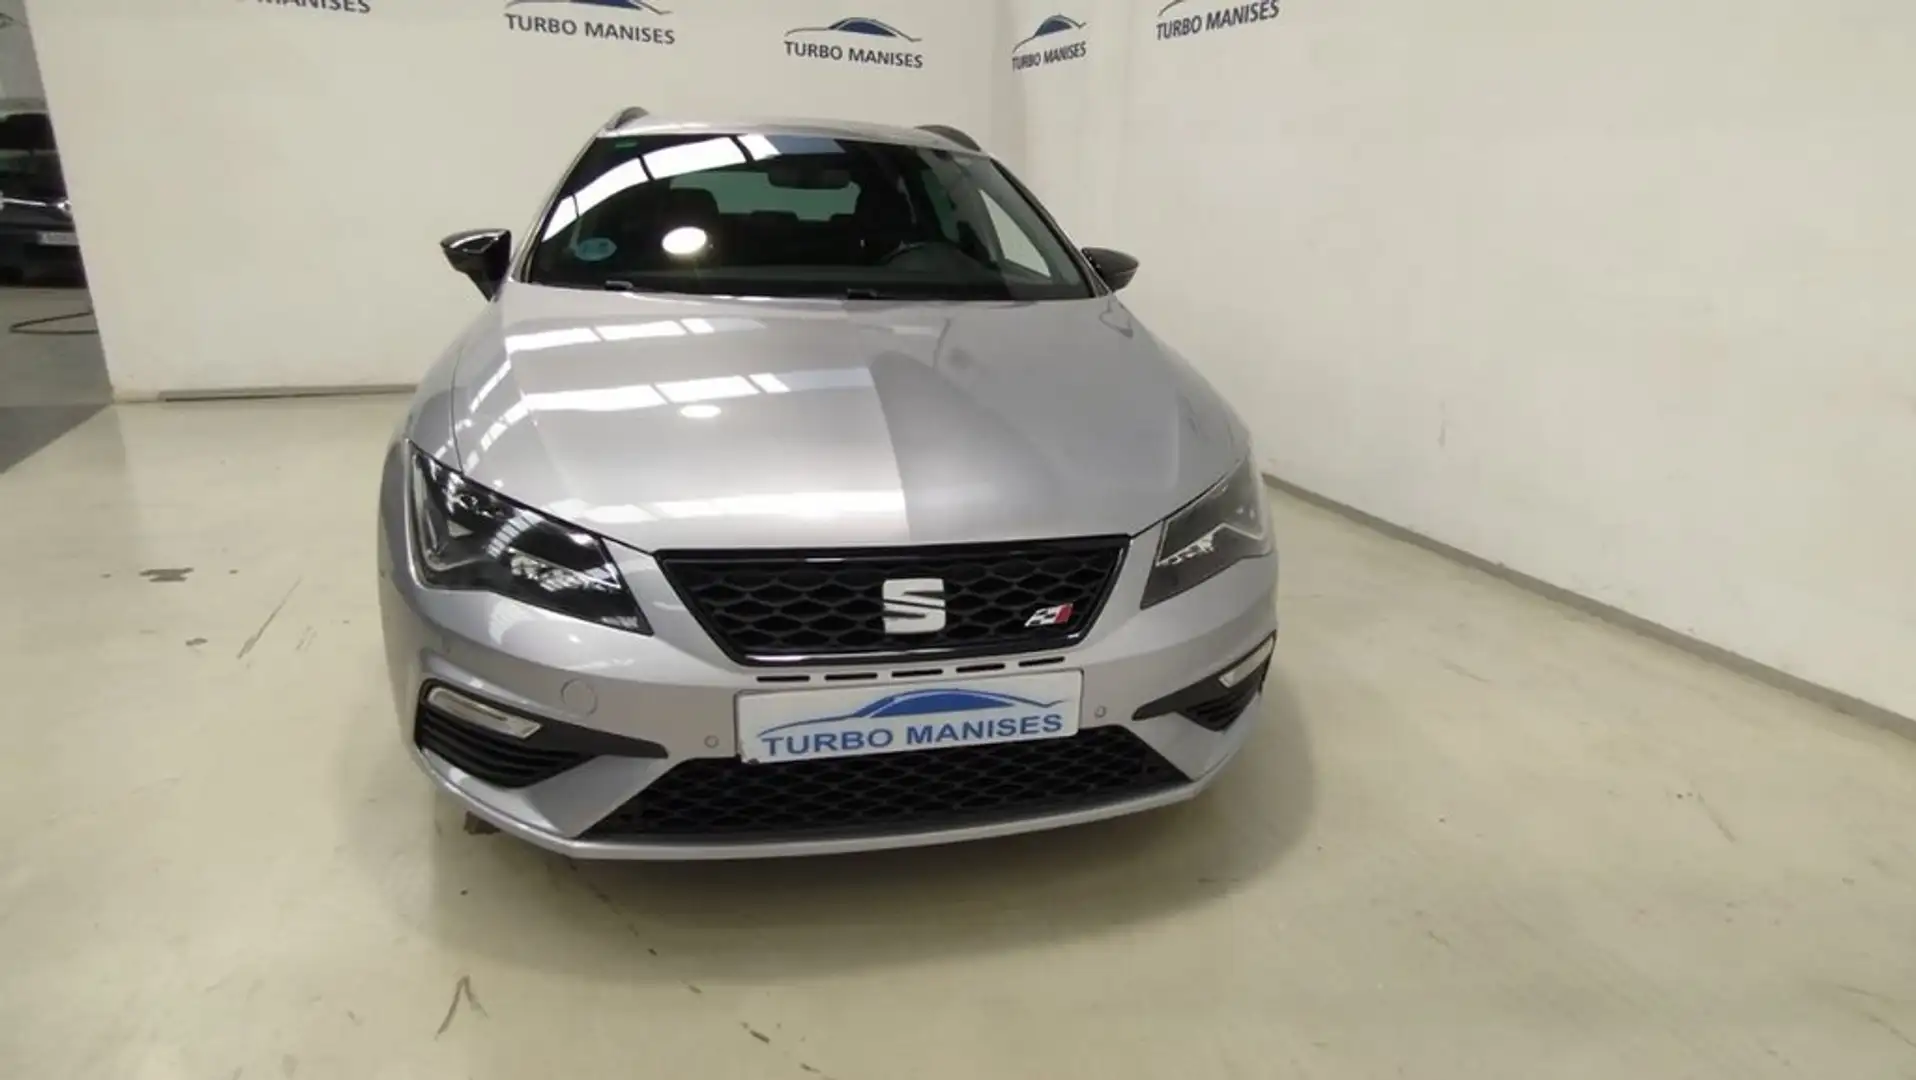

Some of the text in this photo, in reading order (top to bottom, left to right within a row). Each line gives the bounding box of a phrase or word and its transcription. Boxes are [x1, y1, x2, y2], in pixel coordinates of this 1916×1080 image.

[257, 0, 370, 14] NISES
[1156, 0, 1279, 40] TURBO MANISES
[504, 13, 676, 45] TURBO MANISES
[784, 40, 923, 69] TURBO MANISES
[1043, 40, 1086, 64] MANISES
[761, 713, 1063, 757] TURBO MANISES
